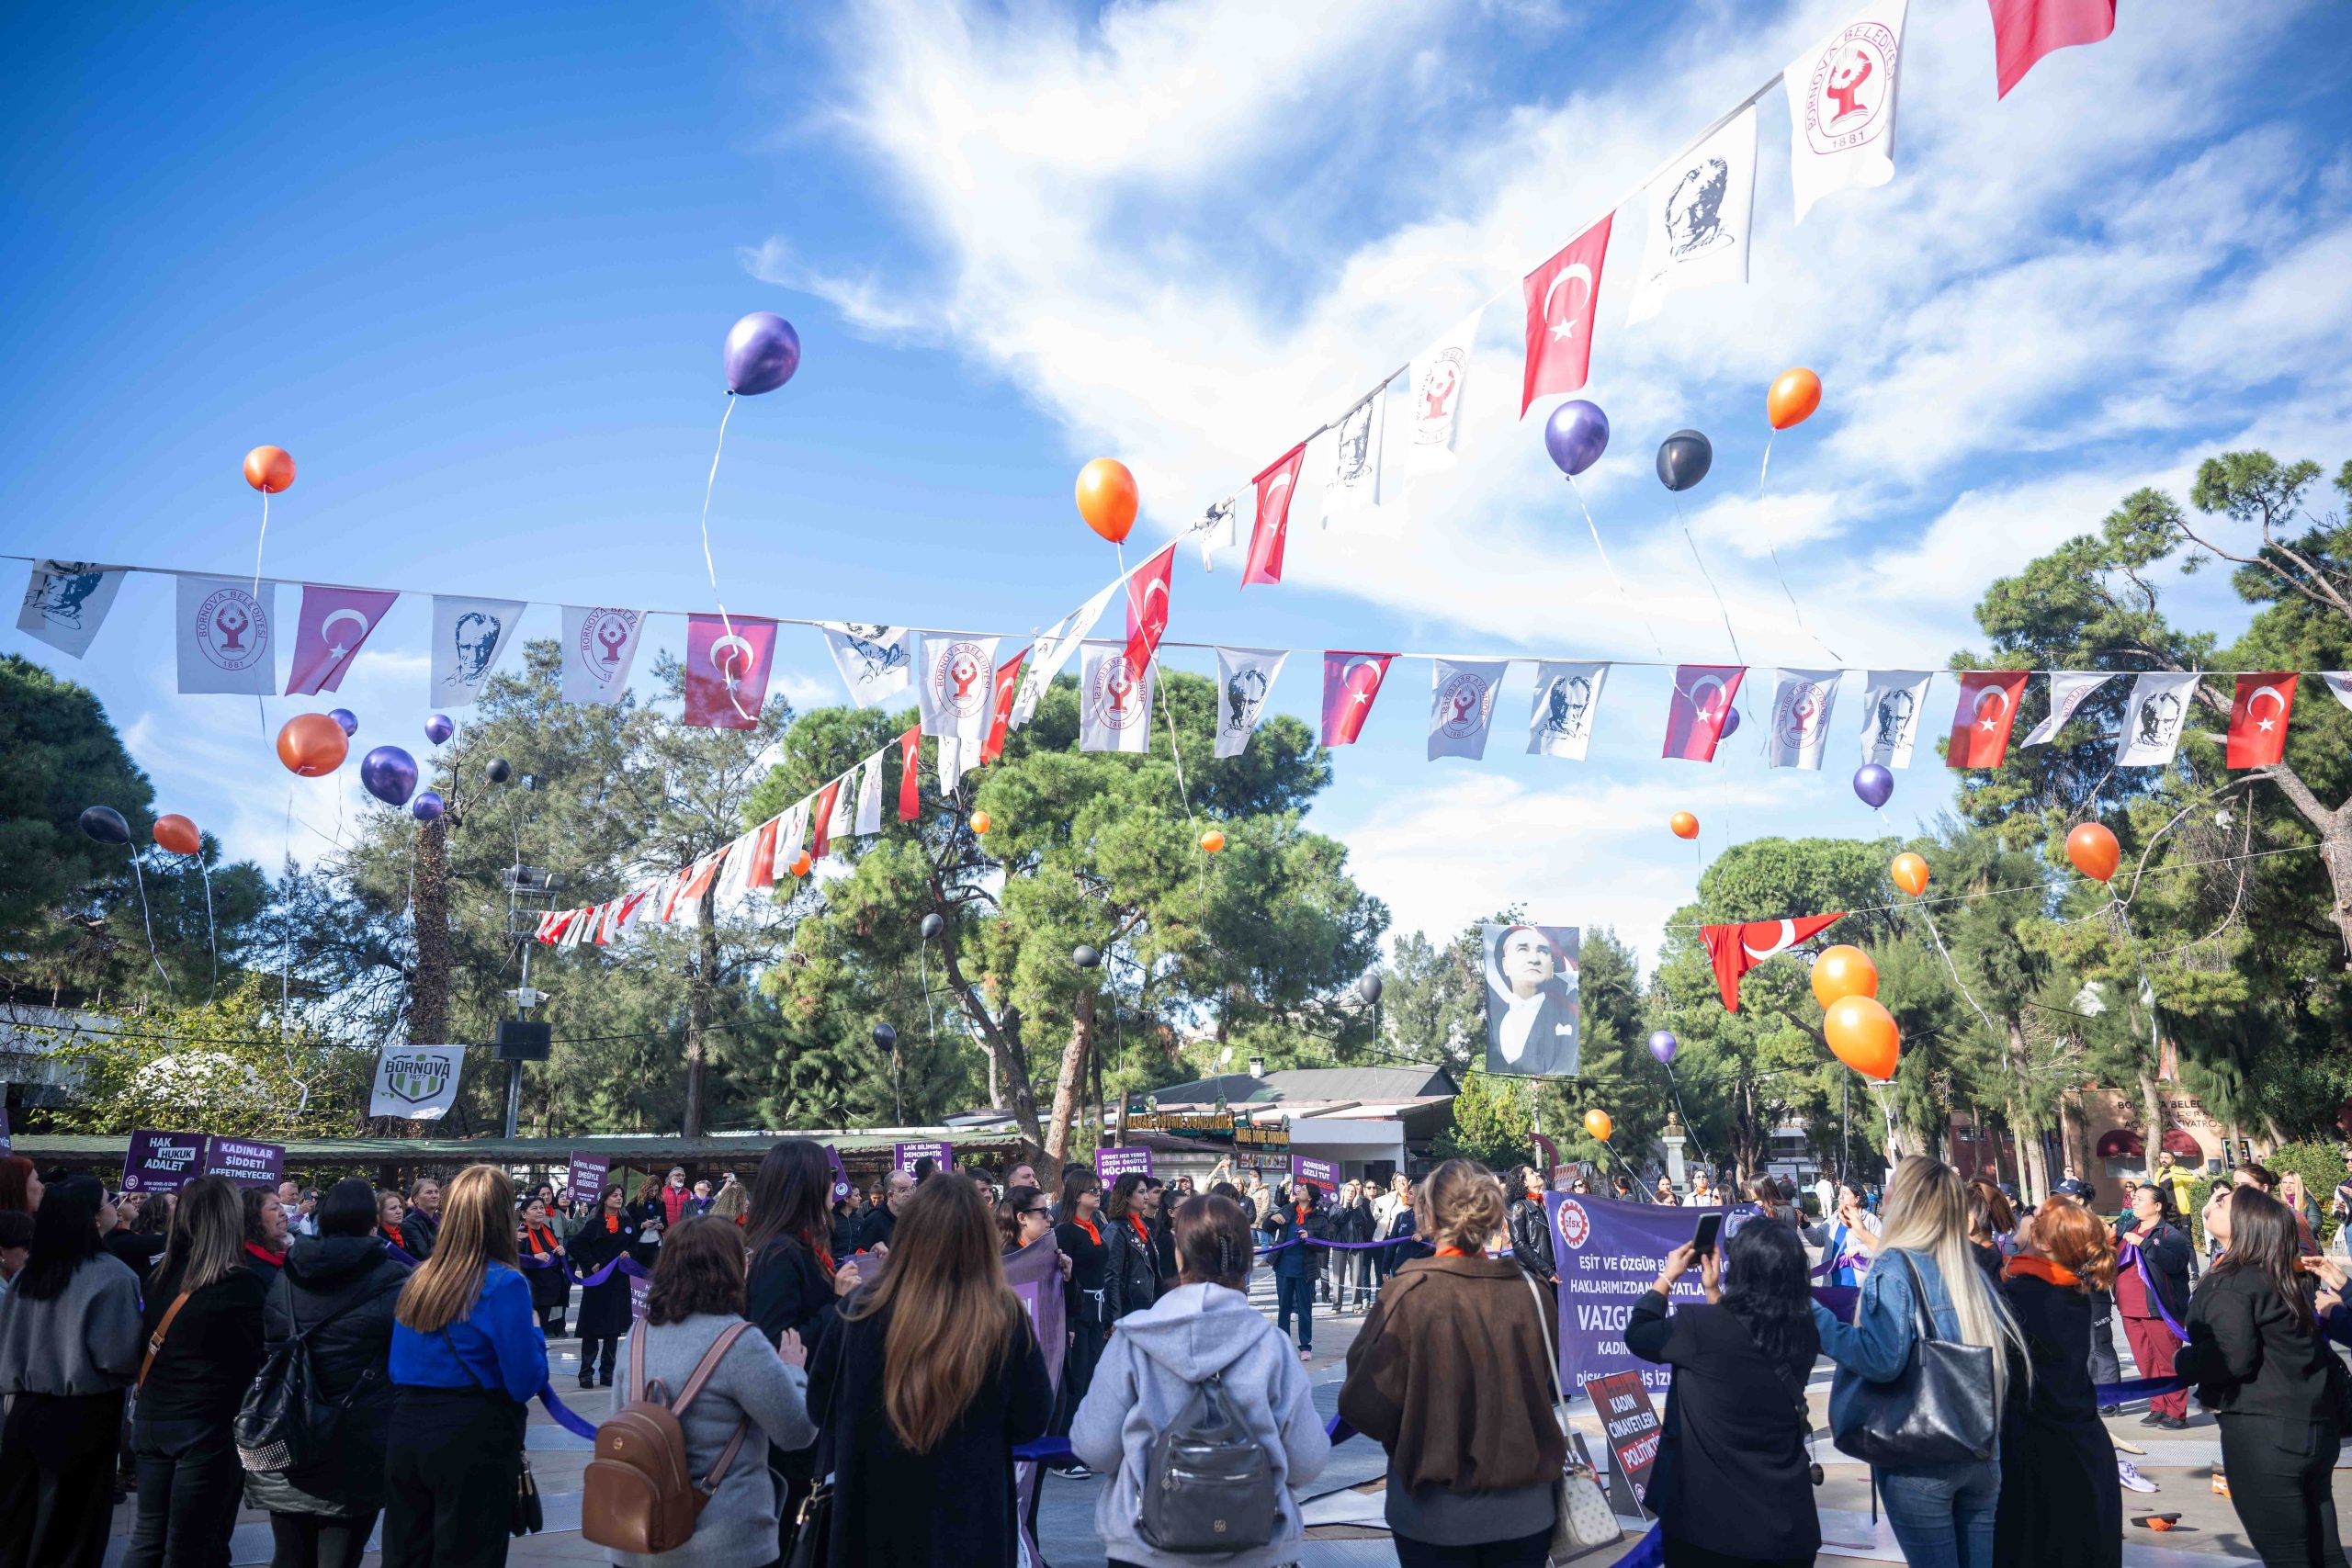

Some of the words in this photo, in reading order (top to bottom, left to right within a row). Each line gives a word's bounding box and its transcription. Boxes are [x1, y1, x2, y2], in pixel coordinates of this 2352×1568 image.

[1833, 130, 1865, 148] 1881
[198, 592, 226, 637] BORNOVA
[582, 607, 607, 651] BORNOVA
[937, 646, 961, 687] BORNOVA
[384, 1060, 451, 1079] BORNOVA
[149, 1137, 173, 1147] HAK
[161, 1148, 193, 1159] HUKUK
[220, 1143, 273, 1158] KADINLAR
[144, 1158, 185, 1171] ADALET
[225, 1155, 266, 1169] ŞİDDETİ
[209, 1168, 275, 1180] AFFETMEYECEK!
[1102, 1165, 1148, 1176] MÜCADELE
[1318, 1171, 1330, 1180] TUT
[1565, 1216, 1581, 1228] DİSK
[1578, 1254, 1600, 1271] EŞİT
[1603, 1257, 1618, 1270] VE
[1620, 1254, 1657, 1272] ÖZGÜR
[1570, 1279, 1652, 1295] HAKLARIMIZDAN
[1609, 1393, 1637, 1414] KADIN
[1608, 1408, 1657, 1439] CİNAYETLERİ
